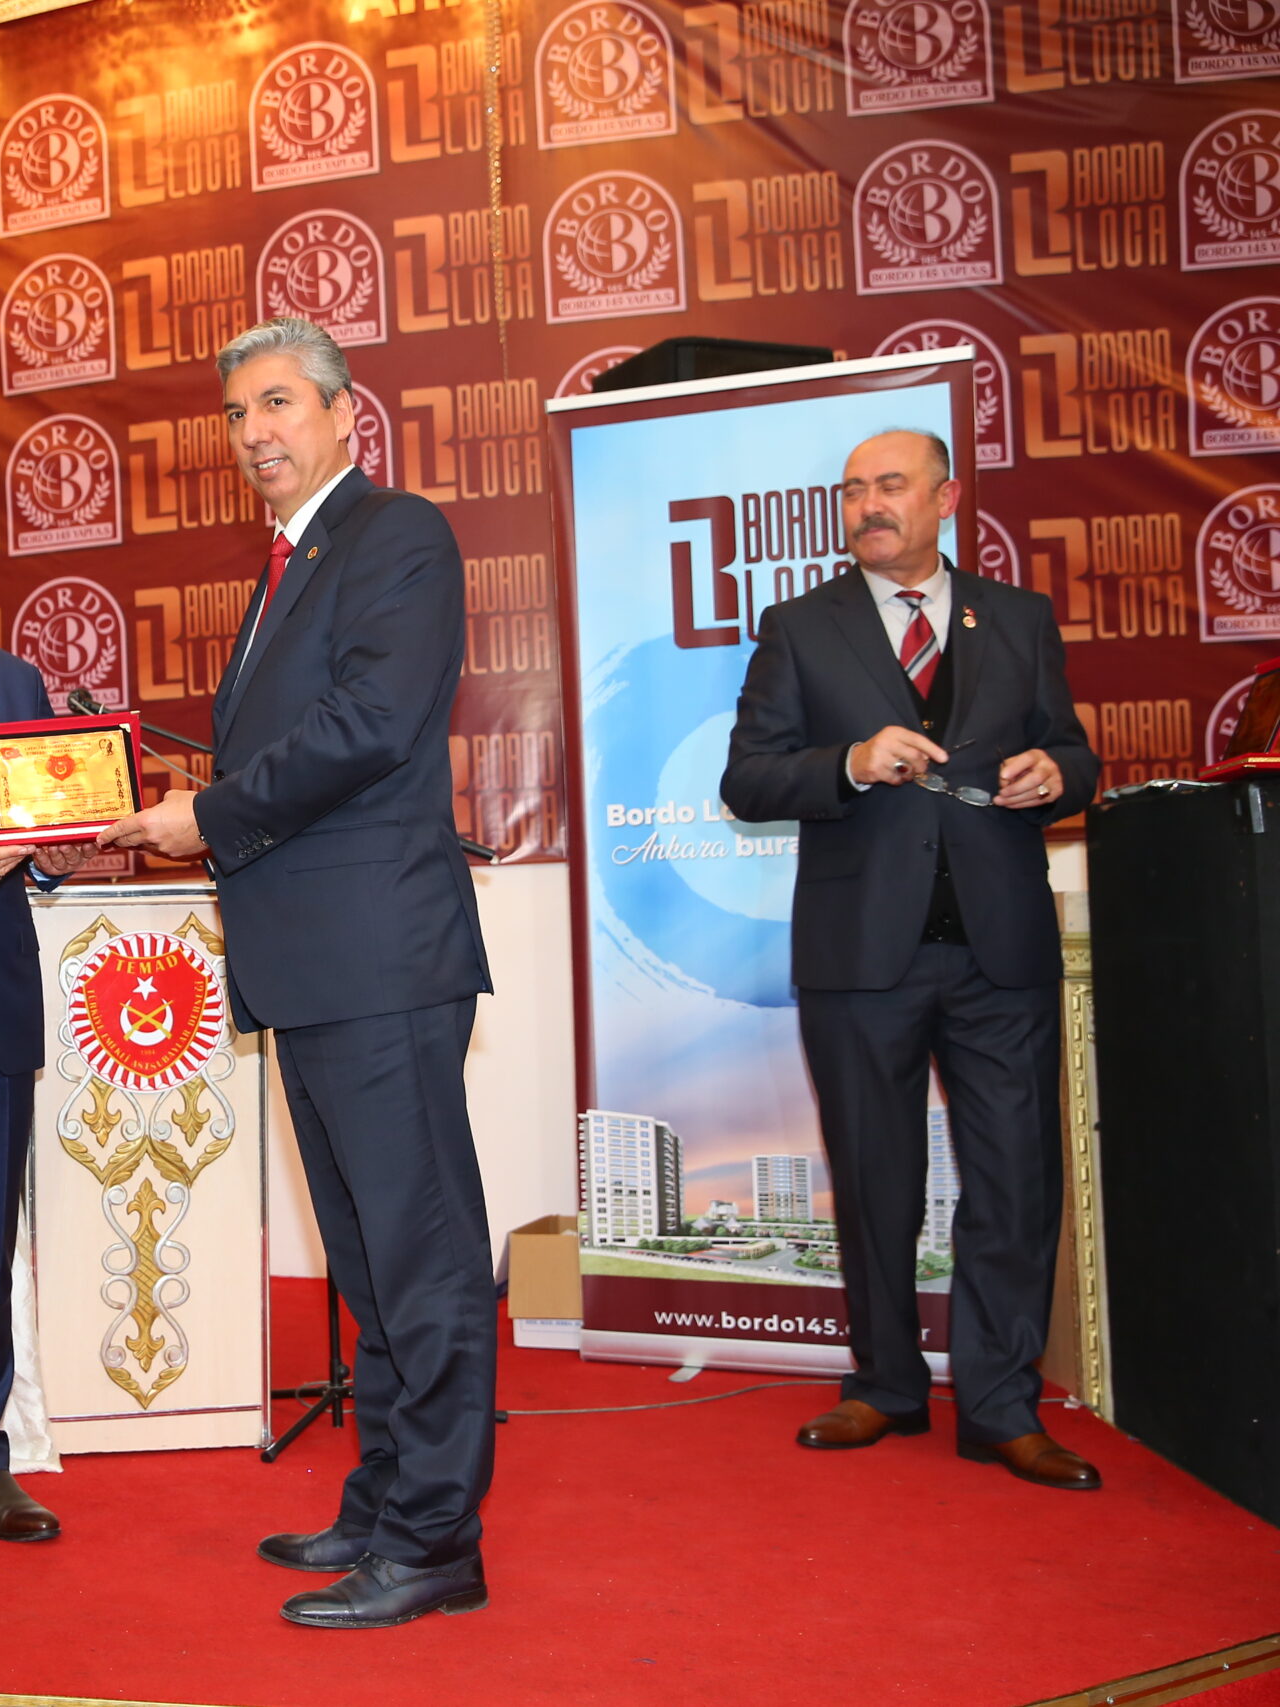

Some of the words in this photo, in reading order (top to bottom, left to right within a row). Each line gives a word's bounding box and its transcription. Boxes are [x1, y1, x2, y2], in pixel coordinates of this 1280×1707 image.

[547, 8, 660, 64] BORDO
[1069, 18, 1160, 86] LOCA
[261, 53, 365, 109] BORDO
[746, 54, 834, 118] LOCA
[6, 105, 99, 158] BORDO
[444, 87, 525, 155] LOA
[1193, 121, 1280, 179] BOR
[168, 134, 241, 199] LOCA
[866, 151, 984, 208] BORDO
[555, 181, 669, 238] BORDO
[1076, 204, 1167, 272] LOCA
[268, 221, 371, 274] BORDO
[755, 230, 843, 296] LOCA
[11, 264, 103, 316] BORDO
[1199, 309, 1280, 366] BOR
[17, 424, 109, 477] BORDO
[178, 412, 236, 471] BORD
[1086, 389, 1176, 454] LOCA
[460, 436, 542, 500] LOCA
[180, 469, 255, 529] LOCA
[1209, 495, 1280, 553] BOR
[22, 587, 115, 638] BORDO
[1096, 576, 1186, 640] LOCA
[470, 613, 550, 675] LOCA
[606, 801, 696, 827] Bordo
[703, 799, 736, 822] Lo
[611, 831, 728, 865] Ankara
[735, 833, 799, 857] bura
[116, 955, 179, 974] TEMAD
